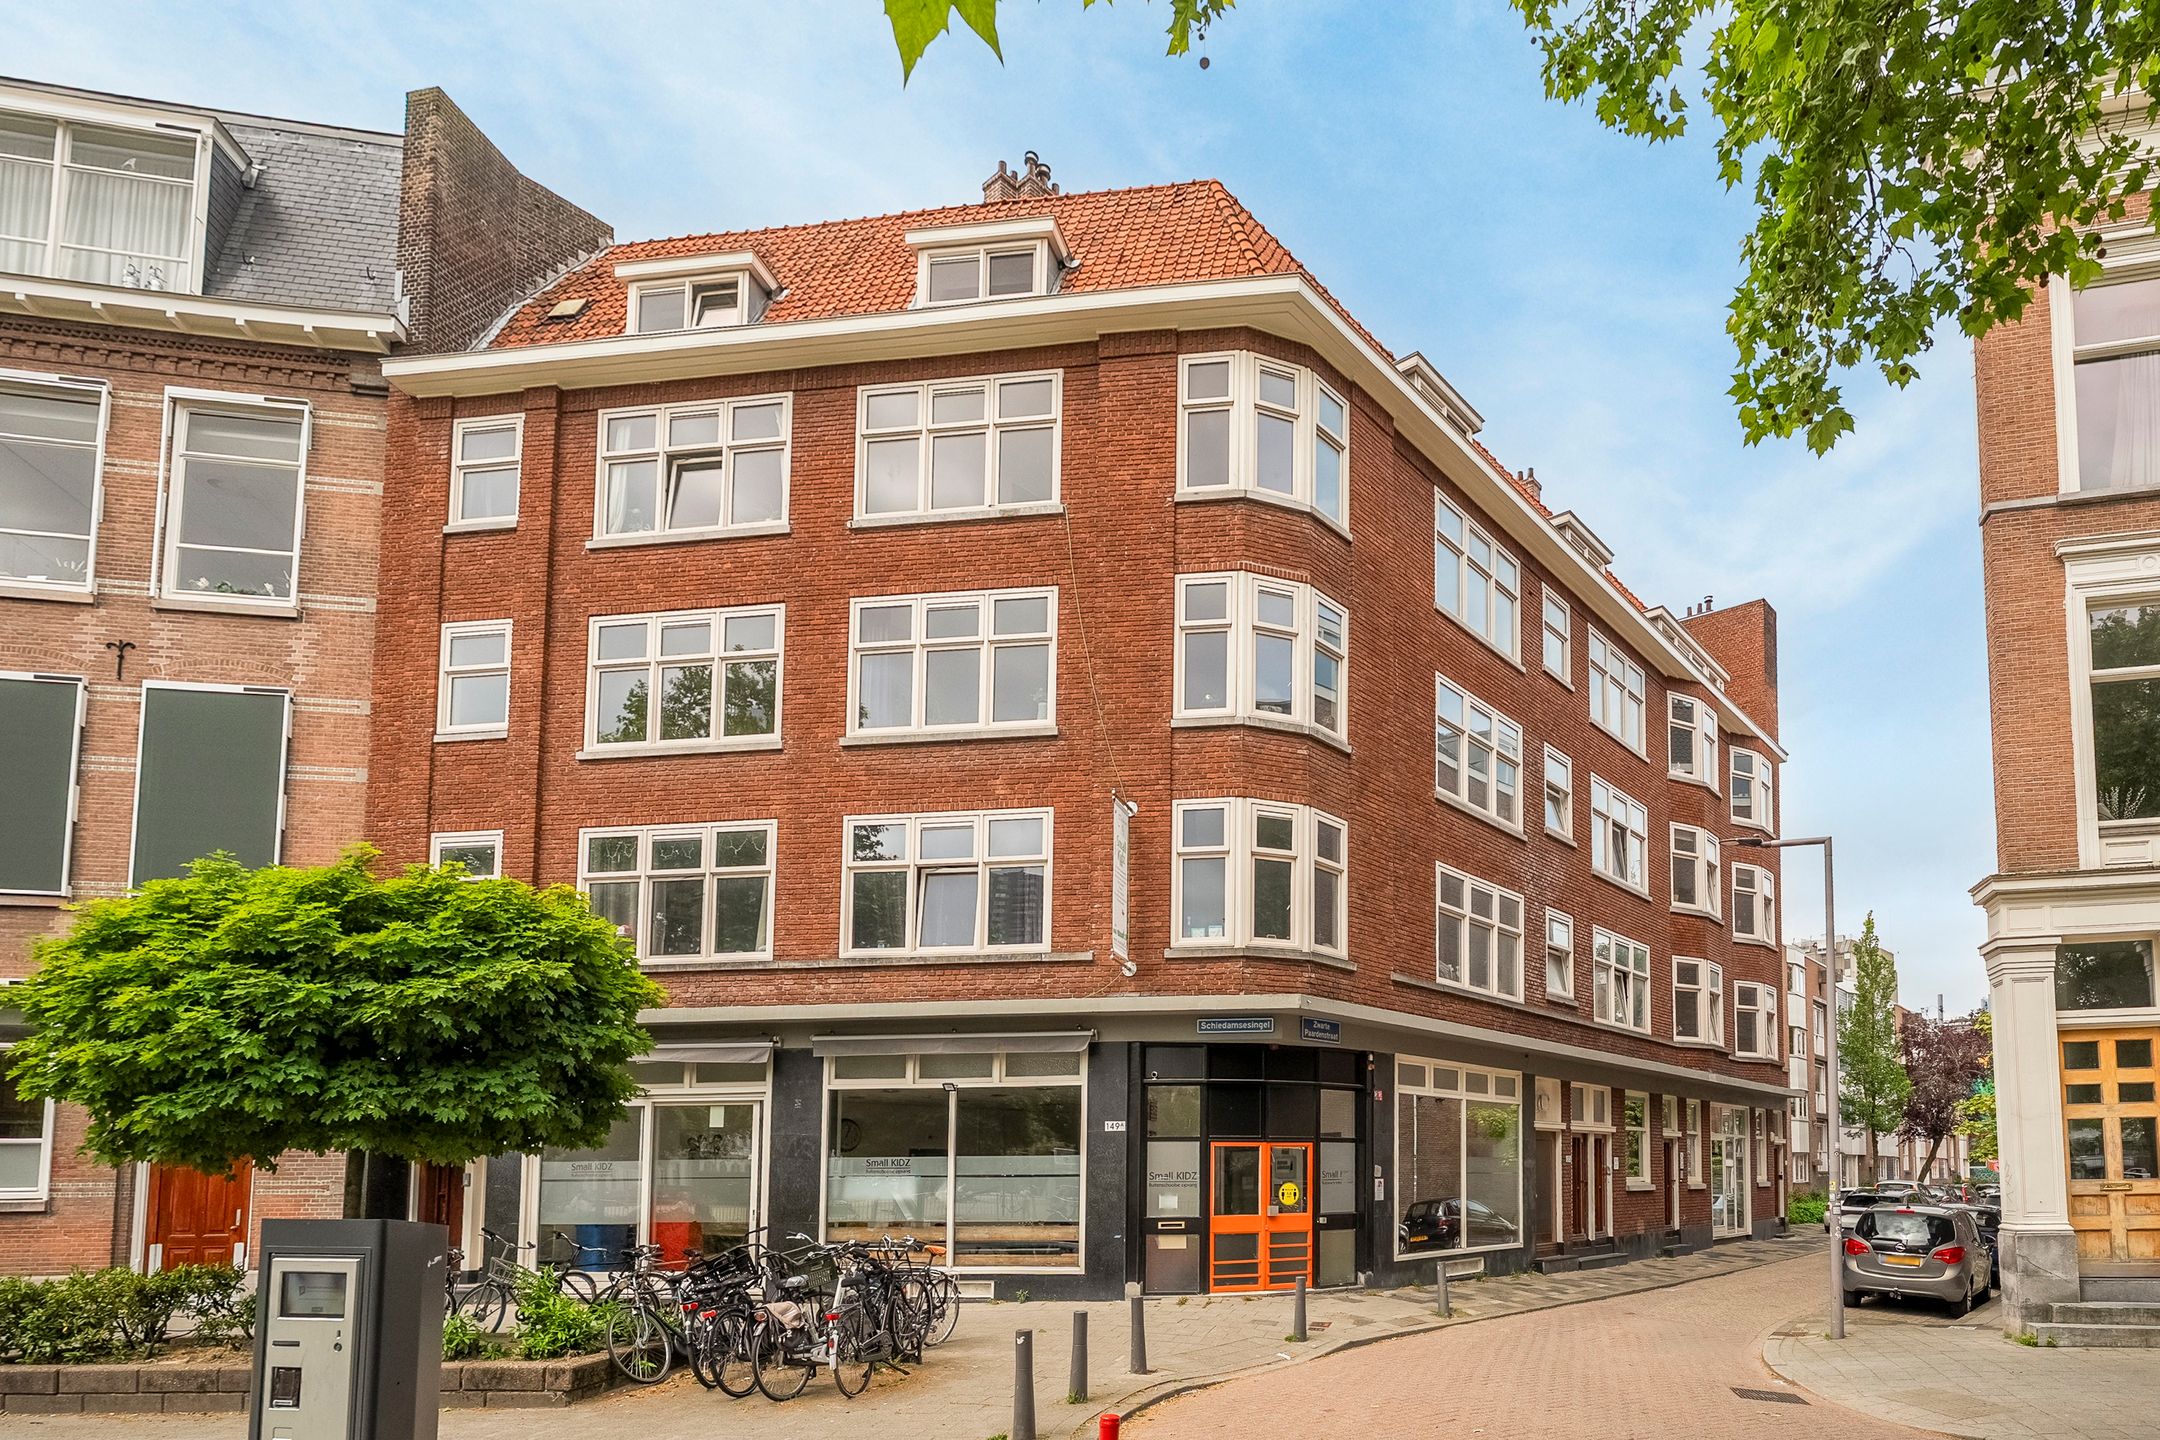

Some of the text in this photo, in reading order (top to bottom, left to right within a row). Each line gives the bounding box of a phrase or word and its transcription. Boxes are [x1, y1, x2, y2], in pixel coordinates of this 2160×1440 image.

[1200, 1021, 1270, 1030] Schiedamsesingel
[1313, 1020, 1330, 1029] Zwarte
[1304, 1028, 1338, 1040] Paardenstraat
[571, 1162, 613, 1171] Small KIDZ
[866, 1158, 911, 1167] Small KIDZ
[1149, 1171, 1197, 1181] Small KIDZ
